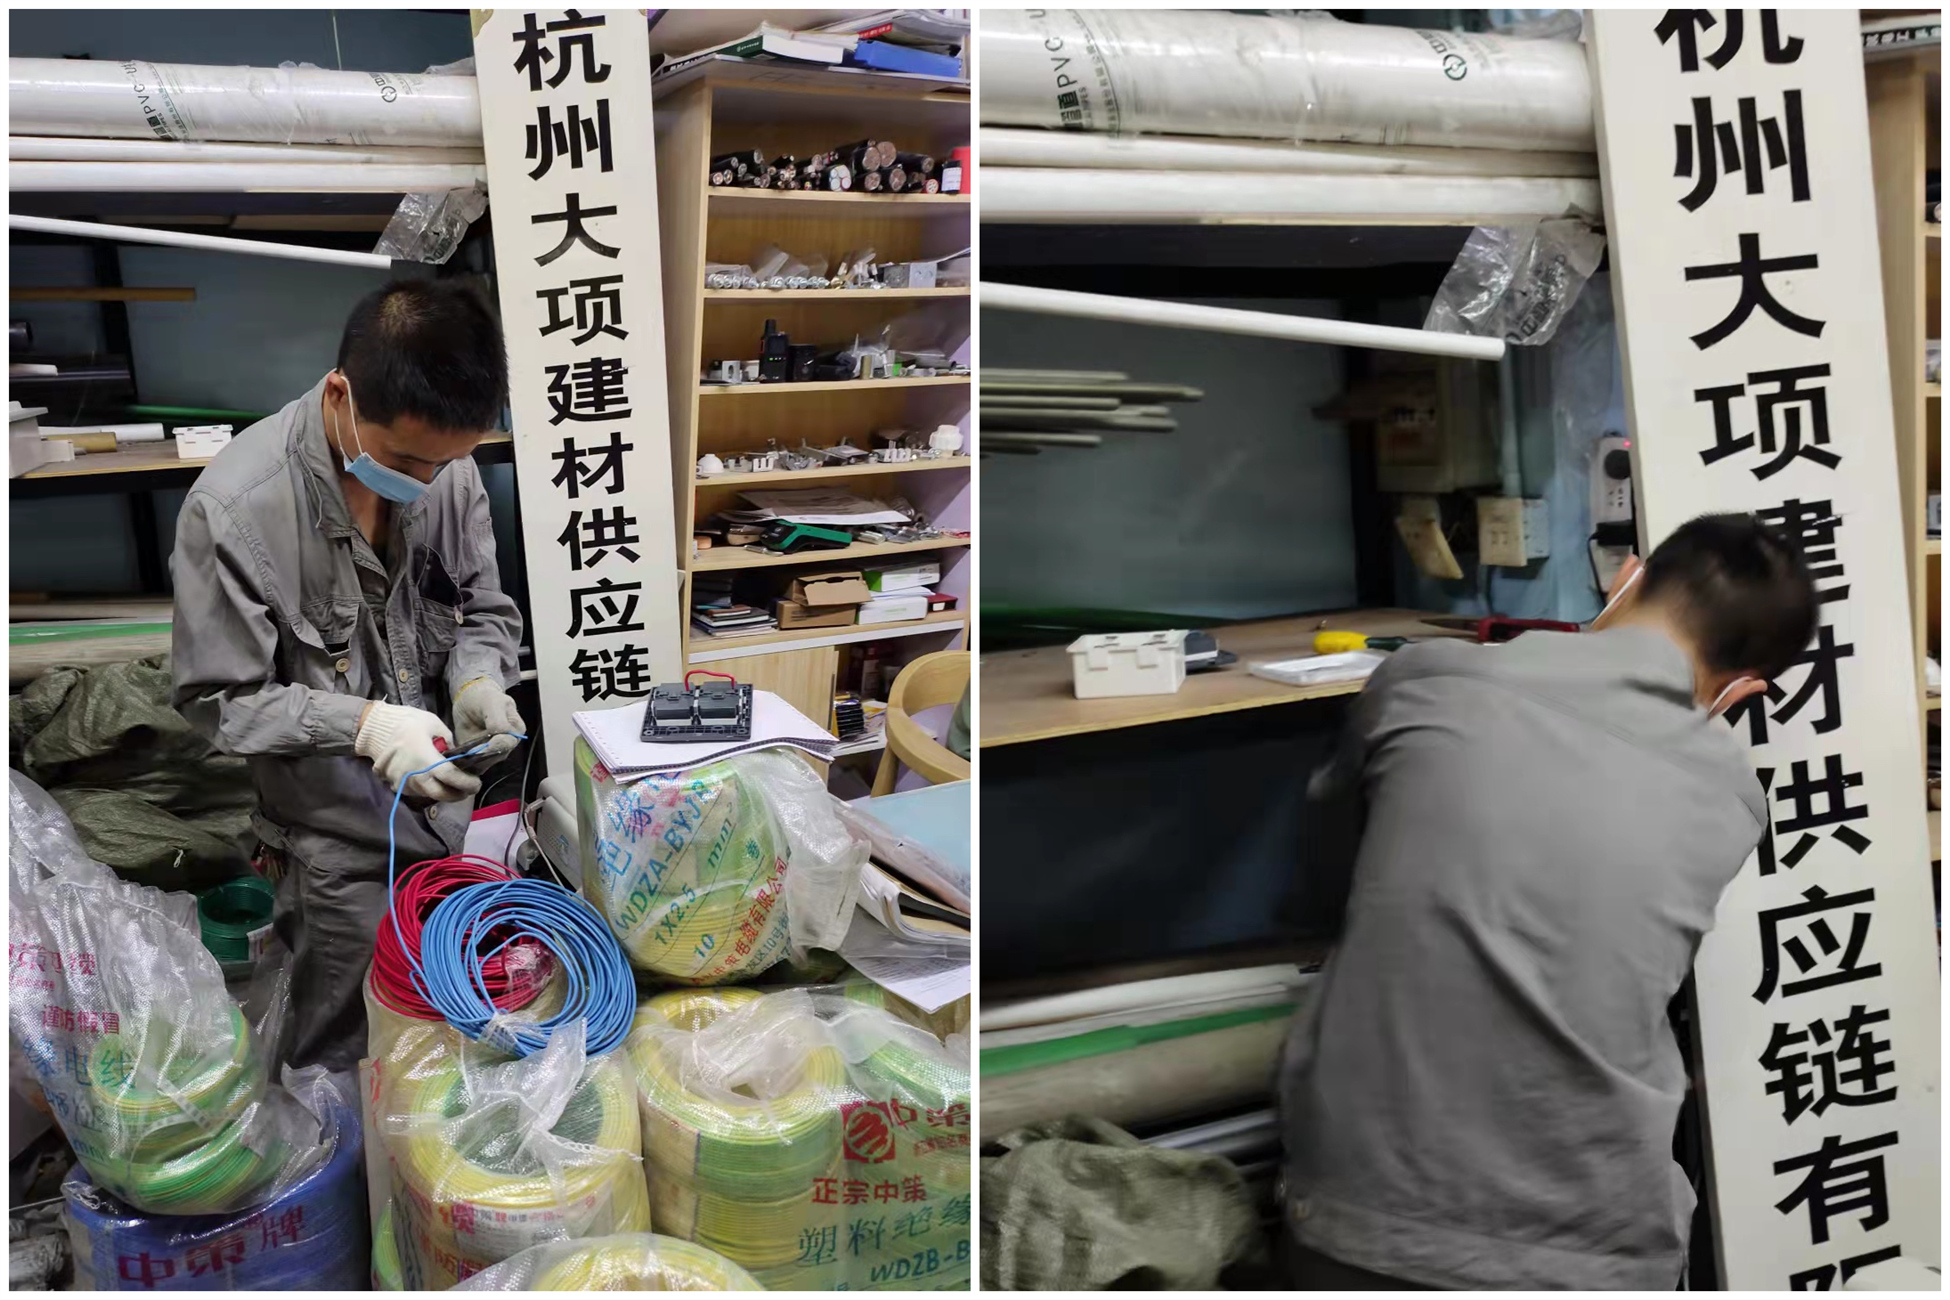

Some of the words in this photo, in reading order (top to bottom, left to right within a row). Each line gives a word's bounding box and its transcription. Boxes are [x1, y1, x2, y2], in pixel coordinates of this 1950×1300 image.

[511, 9, 651, 704] 杭州大项建材供应链
[694, 934, 715, 958] 10
[41, 1004, 120, 1035] 谨防假冒
[812, 1175, 927, 1205] 正宗中策
